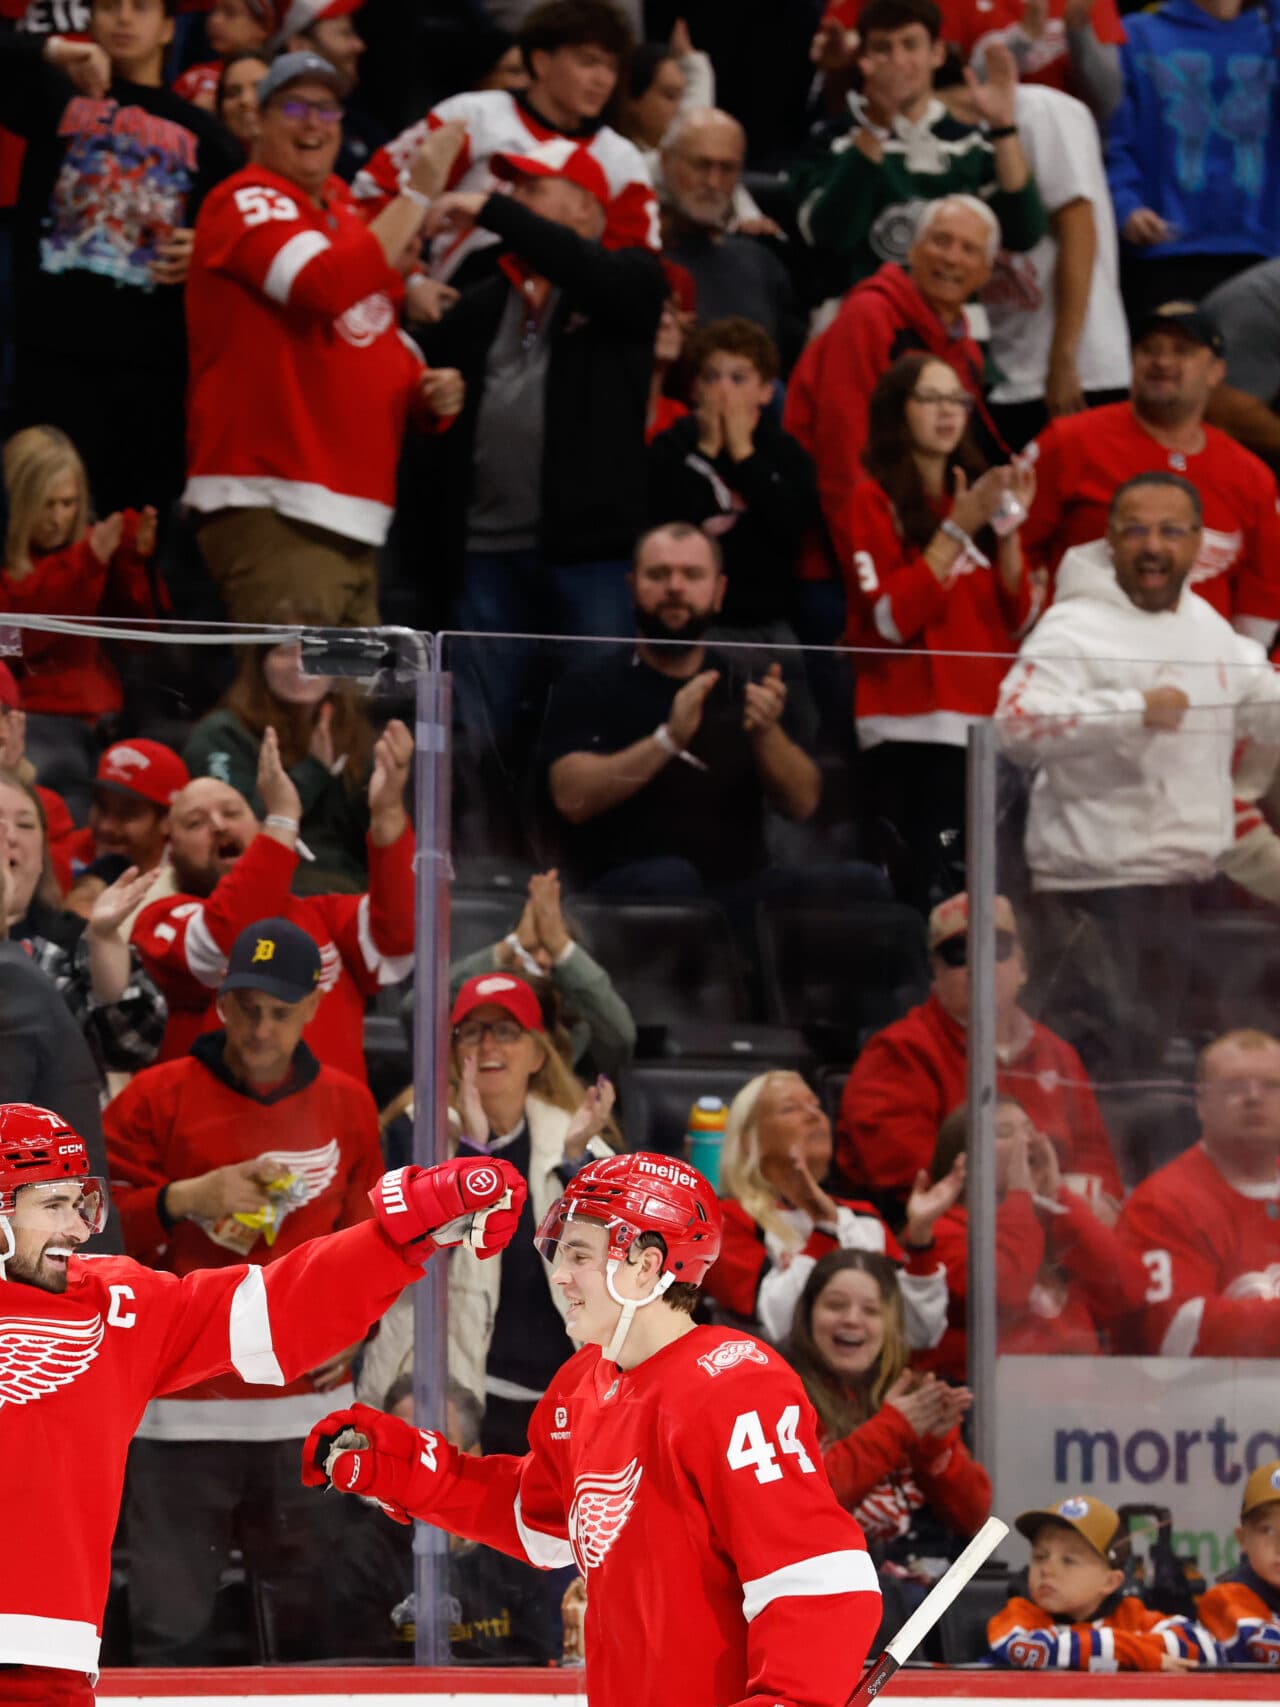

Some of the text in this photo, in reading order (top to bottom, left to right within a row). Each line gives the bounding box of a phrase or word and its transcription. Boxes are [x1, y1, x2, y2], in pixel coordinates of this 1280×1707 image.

[233, 186, 299, 227] 53
[58, 1144, 83, 1155] CCM
[638, 1160, 698, 1189] meijer
[1142, 1249, 1173, 1302] 3
[106, 1284, 136, 1329] C
[726, 1405, 817, 1485] 44
